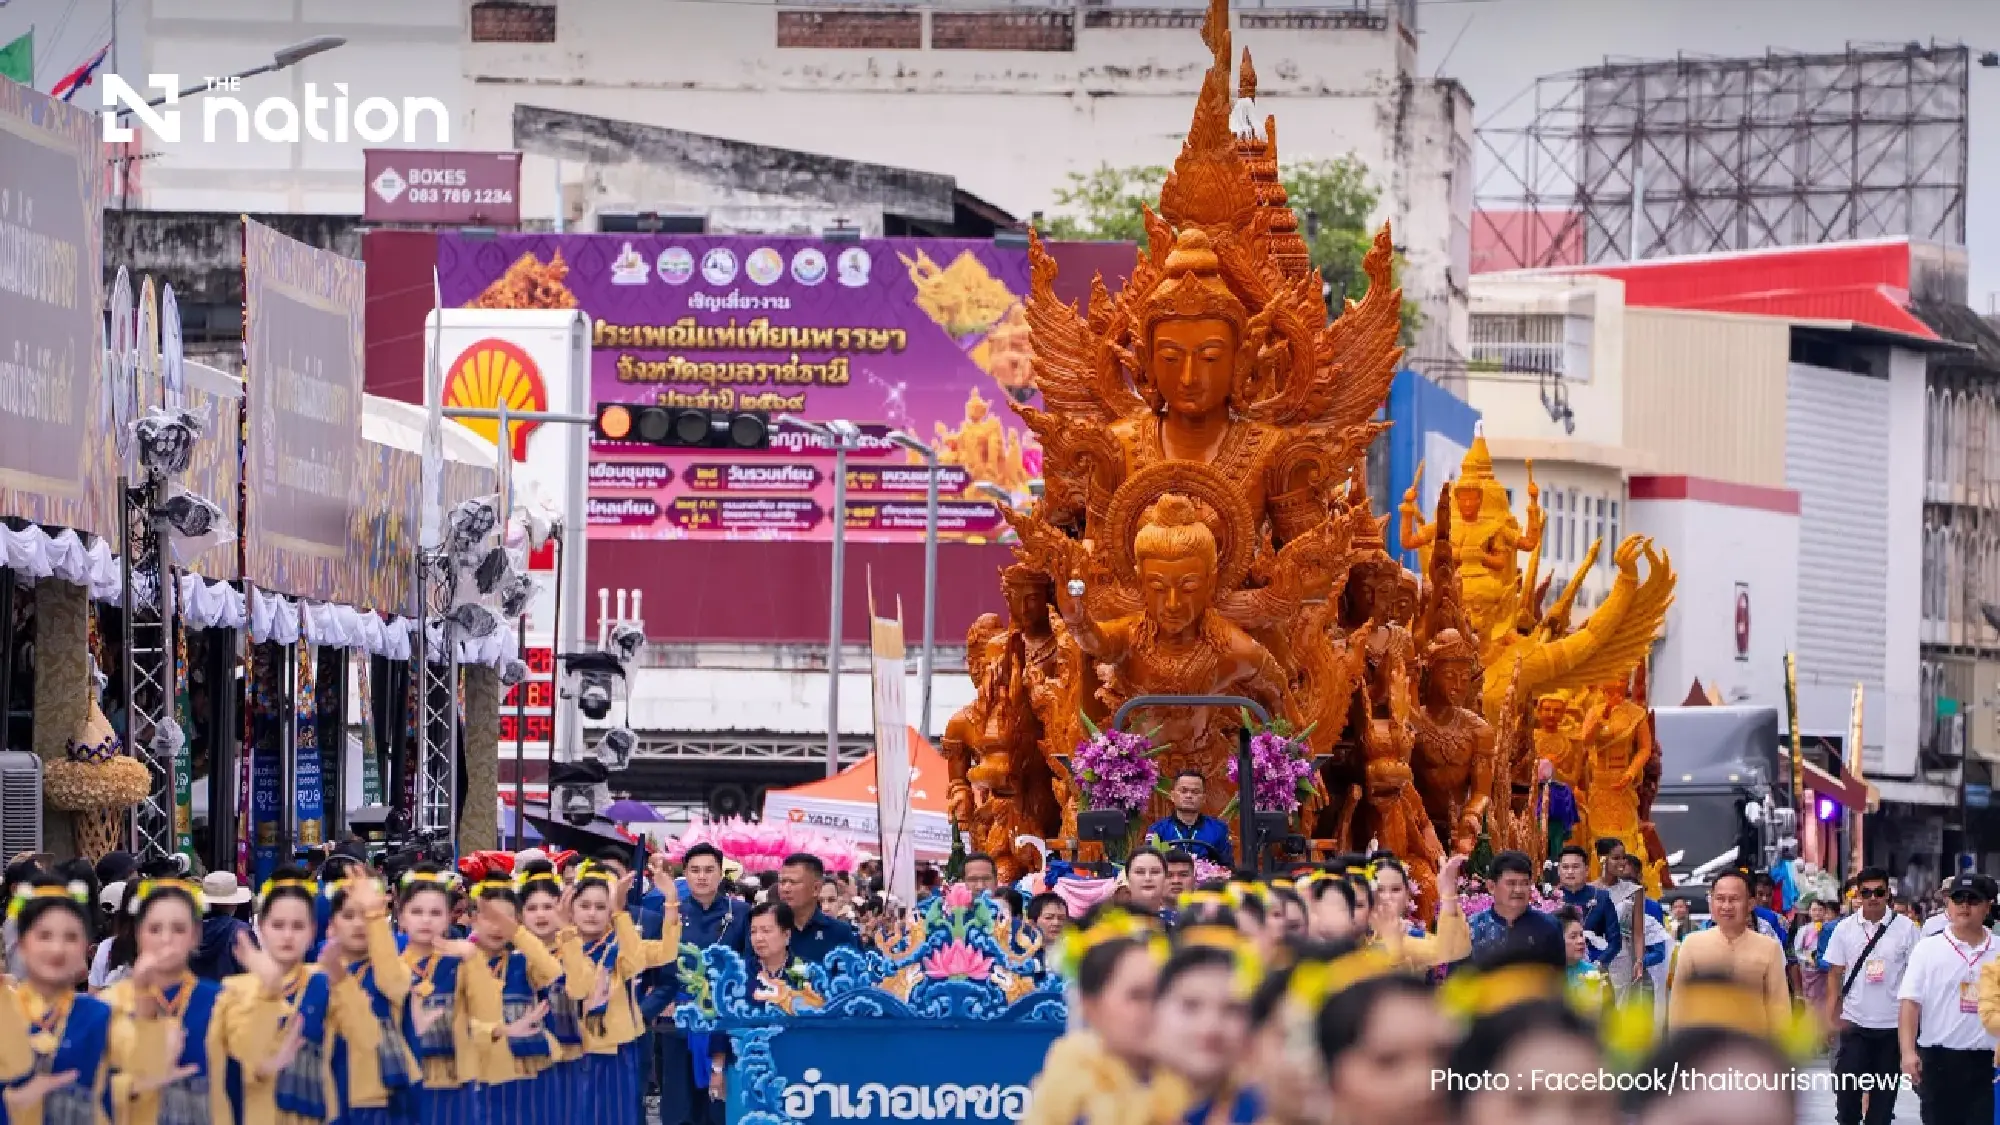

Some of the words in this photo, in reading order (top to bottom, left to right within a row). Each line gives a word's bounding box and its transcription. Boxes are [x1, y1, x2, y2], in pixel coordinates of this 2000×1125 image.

[409, 169, 466, 185] BOXES
[688, 288, 791, 312] เชิญเที่ยวงาน
[617, 353, 849, 387] จังหวัดอุบลราชธานี
[808, 813, 849, 828] YADEA
